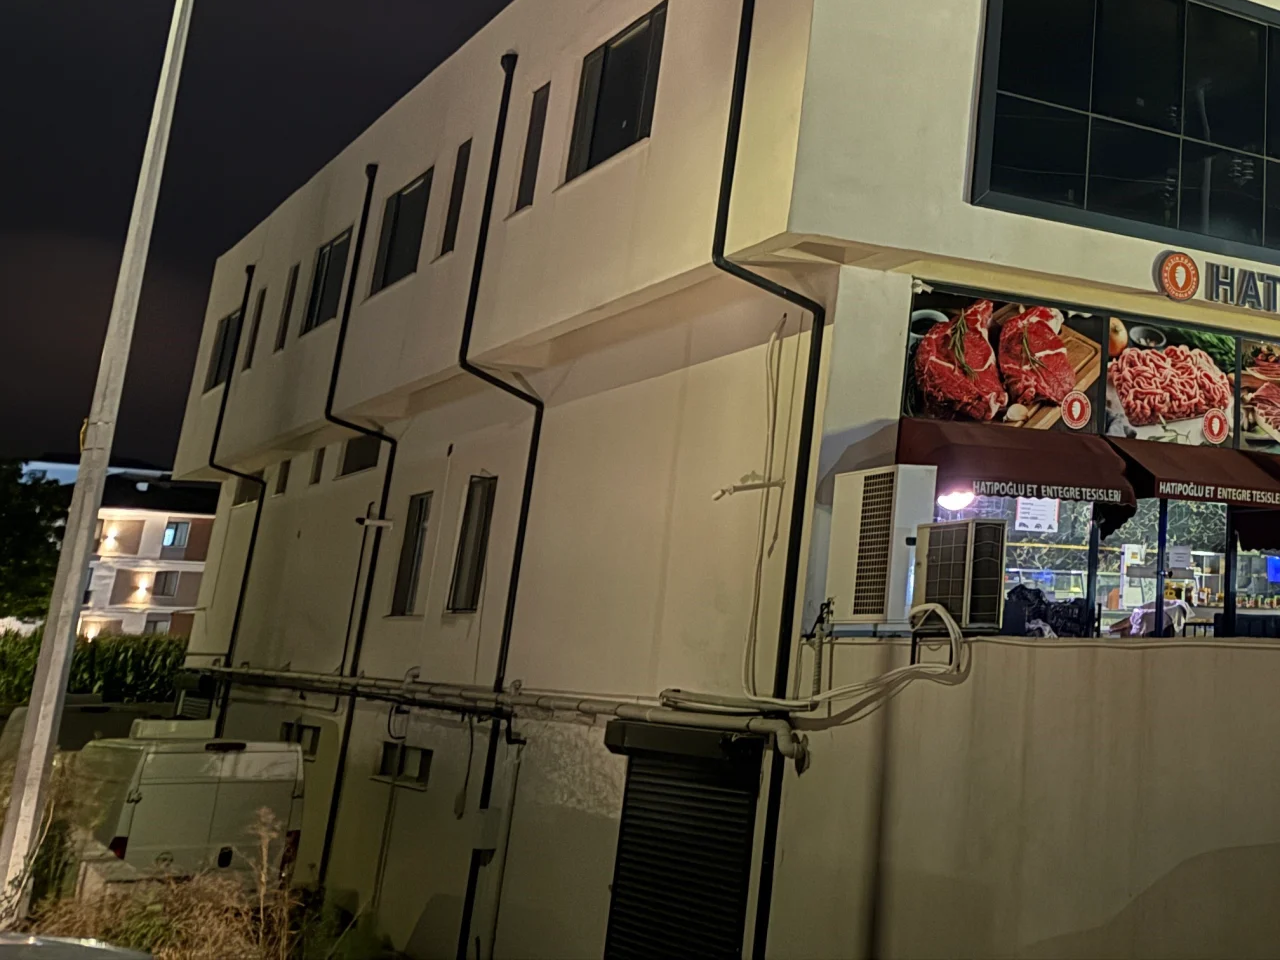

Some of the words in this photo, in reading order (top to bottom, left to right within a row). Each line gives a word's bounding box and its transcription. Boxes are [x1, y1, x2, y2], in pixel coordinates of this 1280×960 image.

[972, 480, 1025, 497] HATİPOĞLU
[1026, 484, 1038, 496] ET
[1041, 486, 1081, 501] ENTEGRE
[1081, 487, 1122, 503] TESİSLERİ
[1159, 481, 1204, 498] HATİPOĞLU
[1204, 486, 1215, 499] ET
[1217, 487, 1251, 502] ENTEGRE
